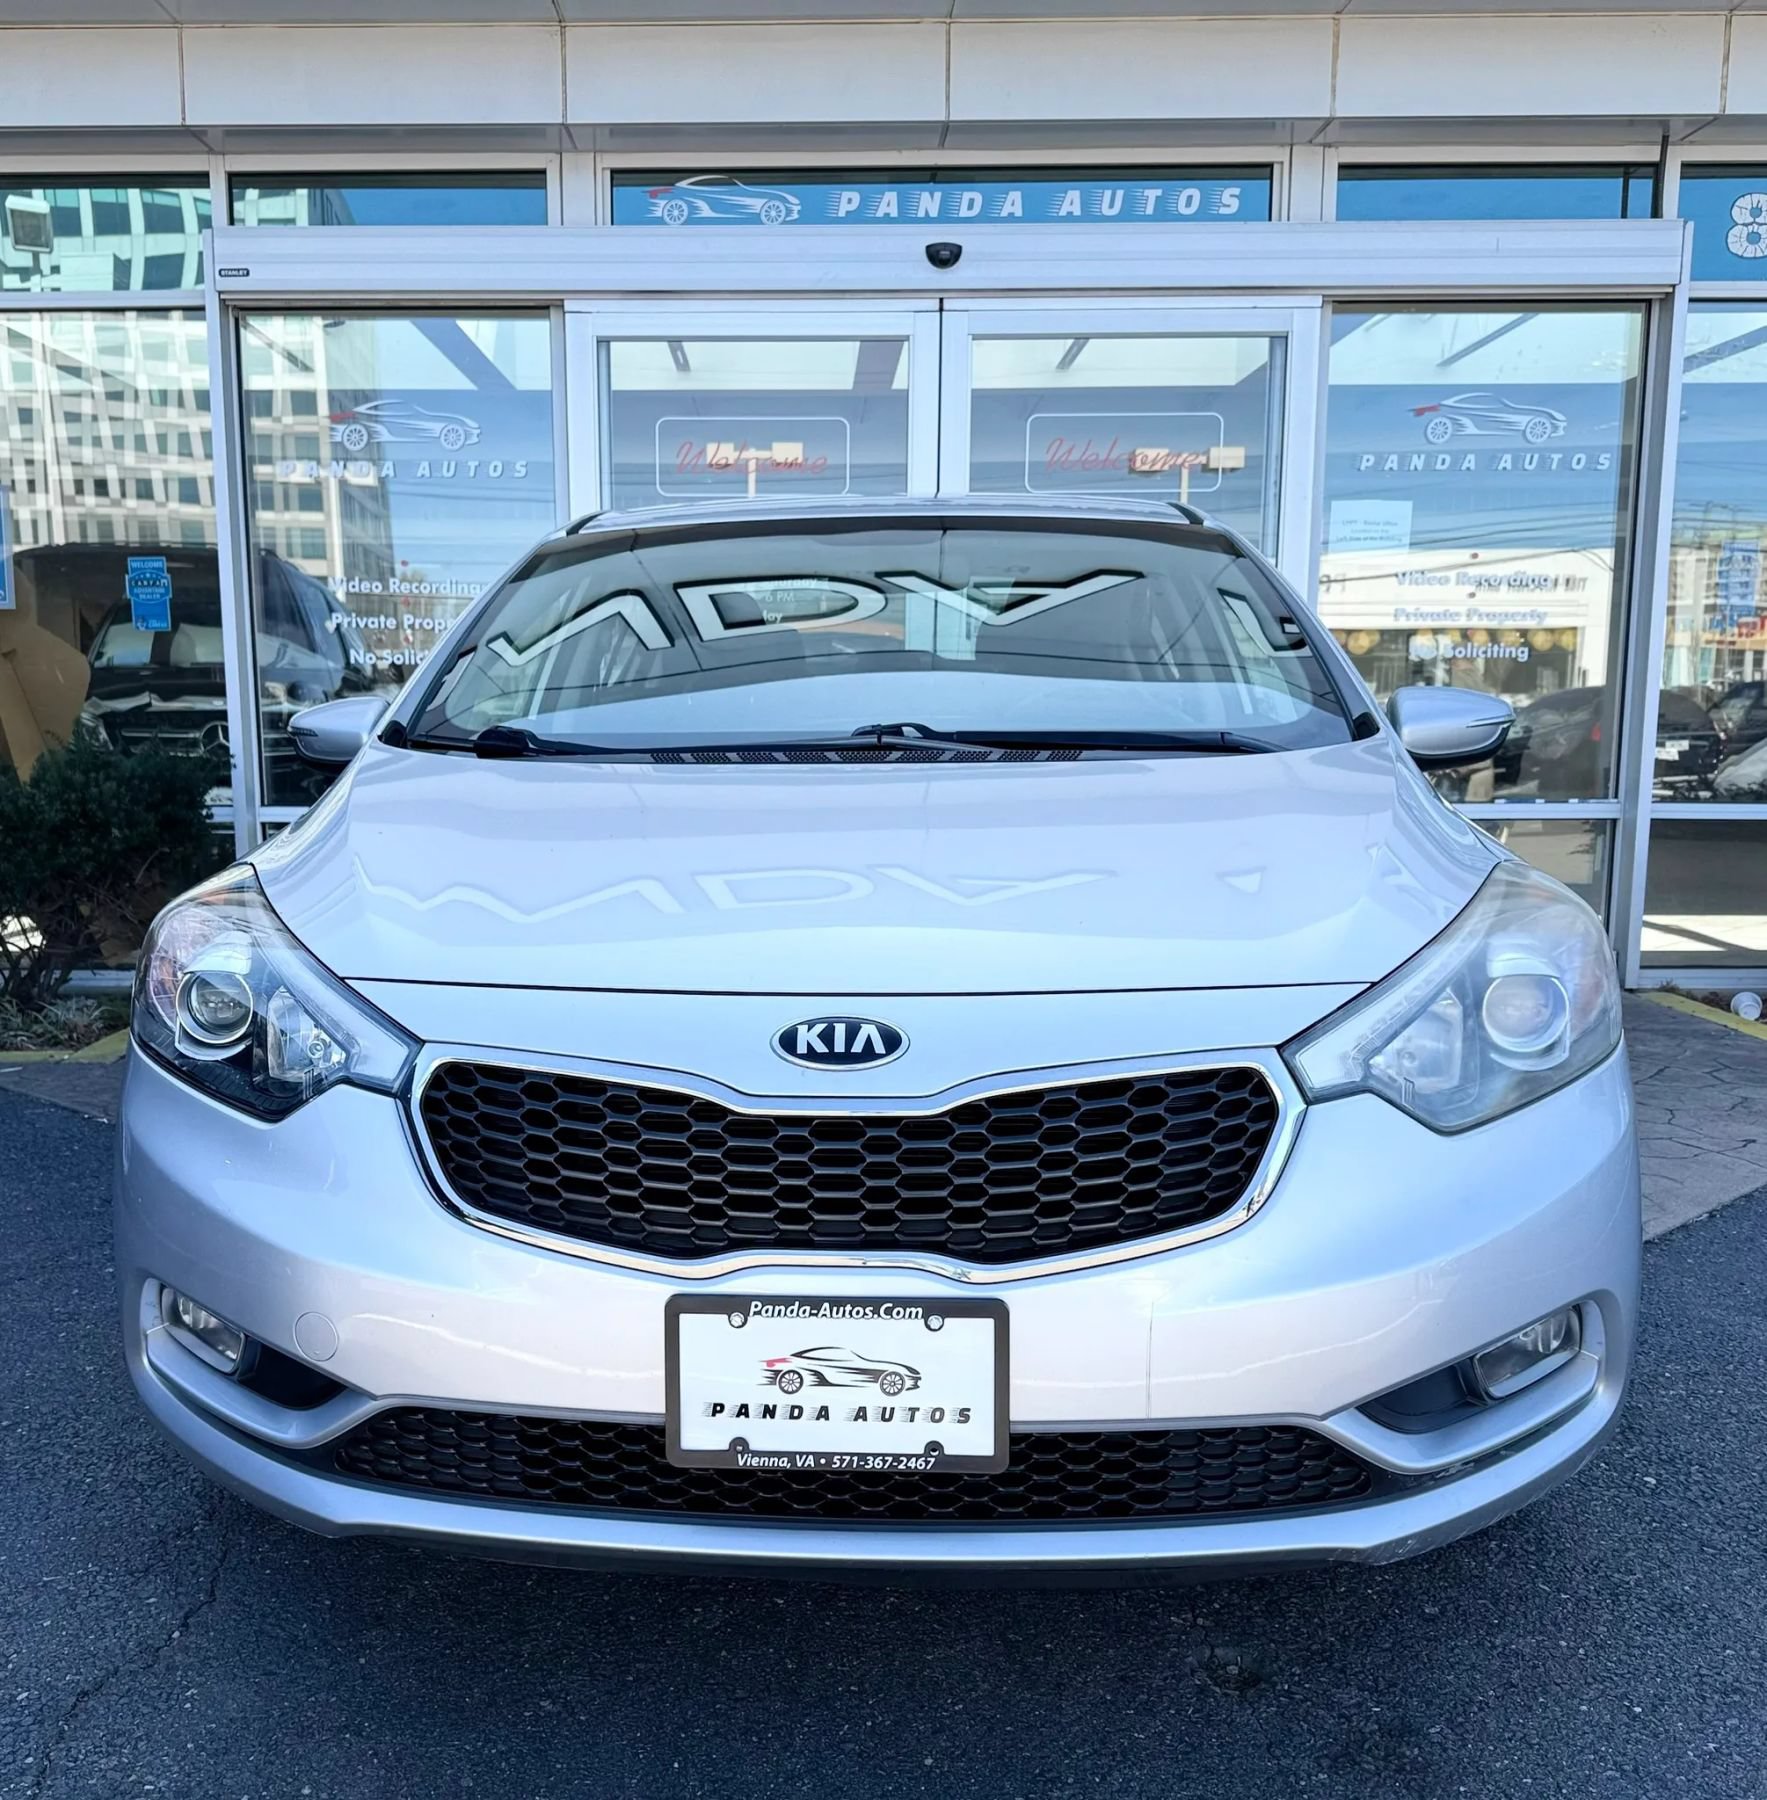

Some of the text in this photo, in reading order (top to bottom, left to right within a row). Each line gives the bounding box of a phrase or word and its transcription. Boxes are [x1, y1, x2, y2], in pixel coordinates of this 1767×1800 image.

[828, 187, 1242, 218] PANDA AUTOS
[1045, 436, 1201, 472] Welcome
[1358, 453, 1612, 471] PANDA AUTOS
[279, 460, 529, 478] PANDA AUTOS
[328, 576, 382, 594] Video
[1397, 570, 1450, 586] Video
[1456, 571, 1551, 589] Recording
[331, 612, 451, 634] Private Prop
[1393, 608, 1548, 625] Private Property
[351, 649, 377, 665] No
[796, 1022, 886, 1054] KIA
[749, 1300, 924, 1321] Panda-Autos.Com
[704, 1402, 971, 1424] PANDA AUTOS
[736, 1453, 936, 1470] Vienna, VA 571-367-2467
